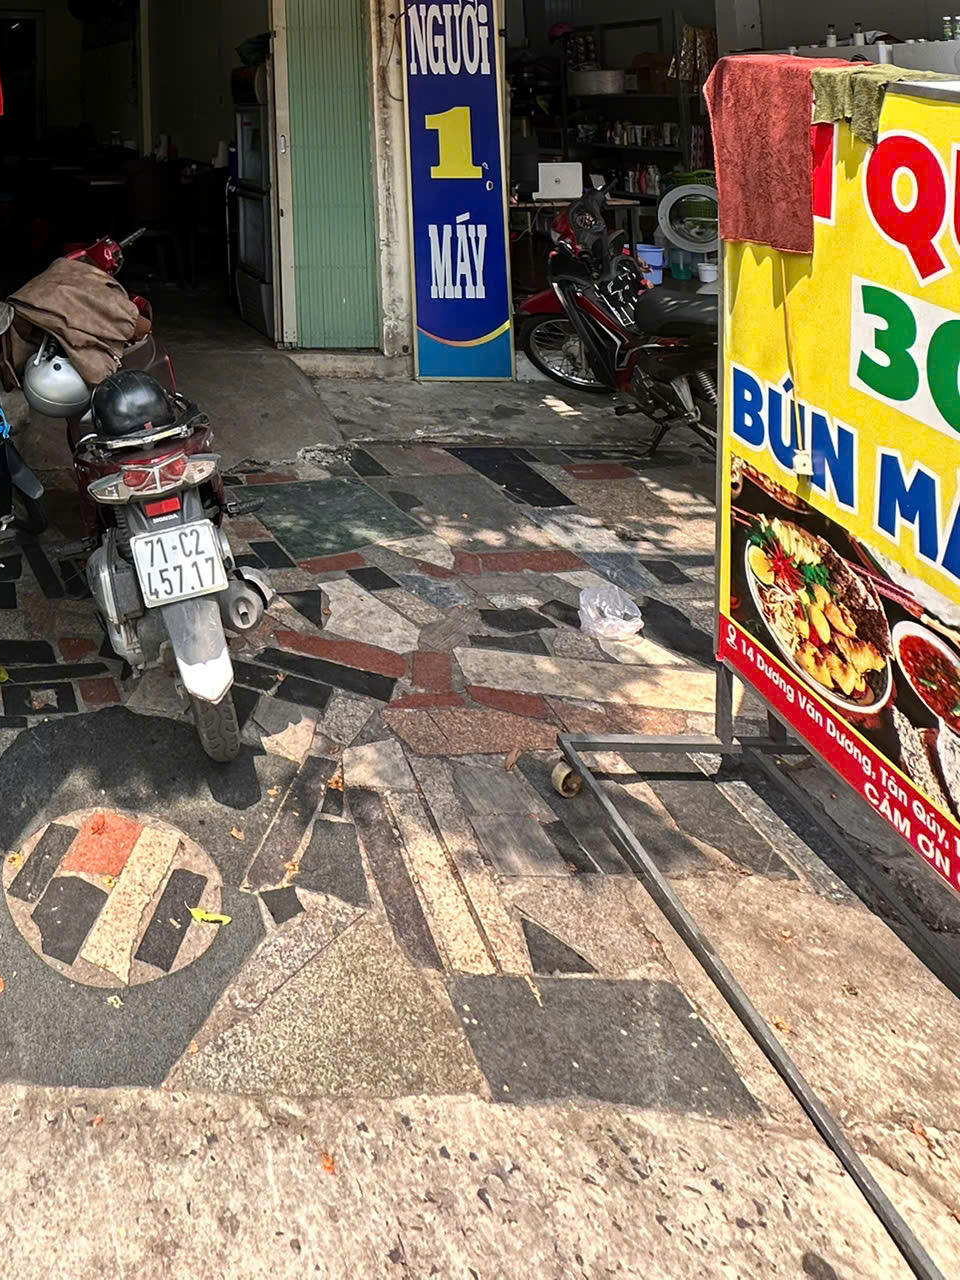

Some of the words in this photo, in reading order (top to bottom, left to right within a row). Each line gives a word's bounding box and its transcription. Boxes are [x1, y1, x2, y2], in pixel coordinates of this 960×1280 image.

[424, 106, 483, 179] 1
[428, 211, 487, 299] MÁY
[731, 368, 855, 508] BÚN
[147, 557, 215, 599] 457.17
[741, 639, 755, 662] 14
[756, 653, 795, 704] Dương
[798, 690, 823, 727] Văn
[826, 718, 877, 780] Dương,
[879, 767, 908, 807] Tân
[864, 782, 911, 839] CẢM
[917, 832, 951, 878] ƠN
